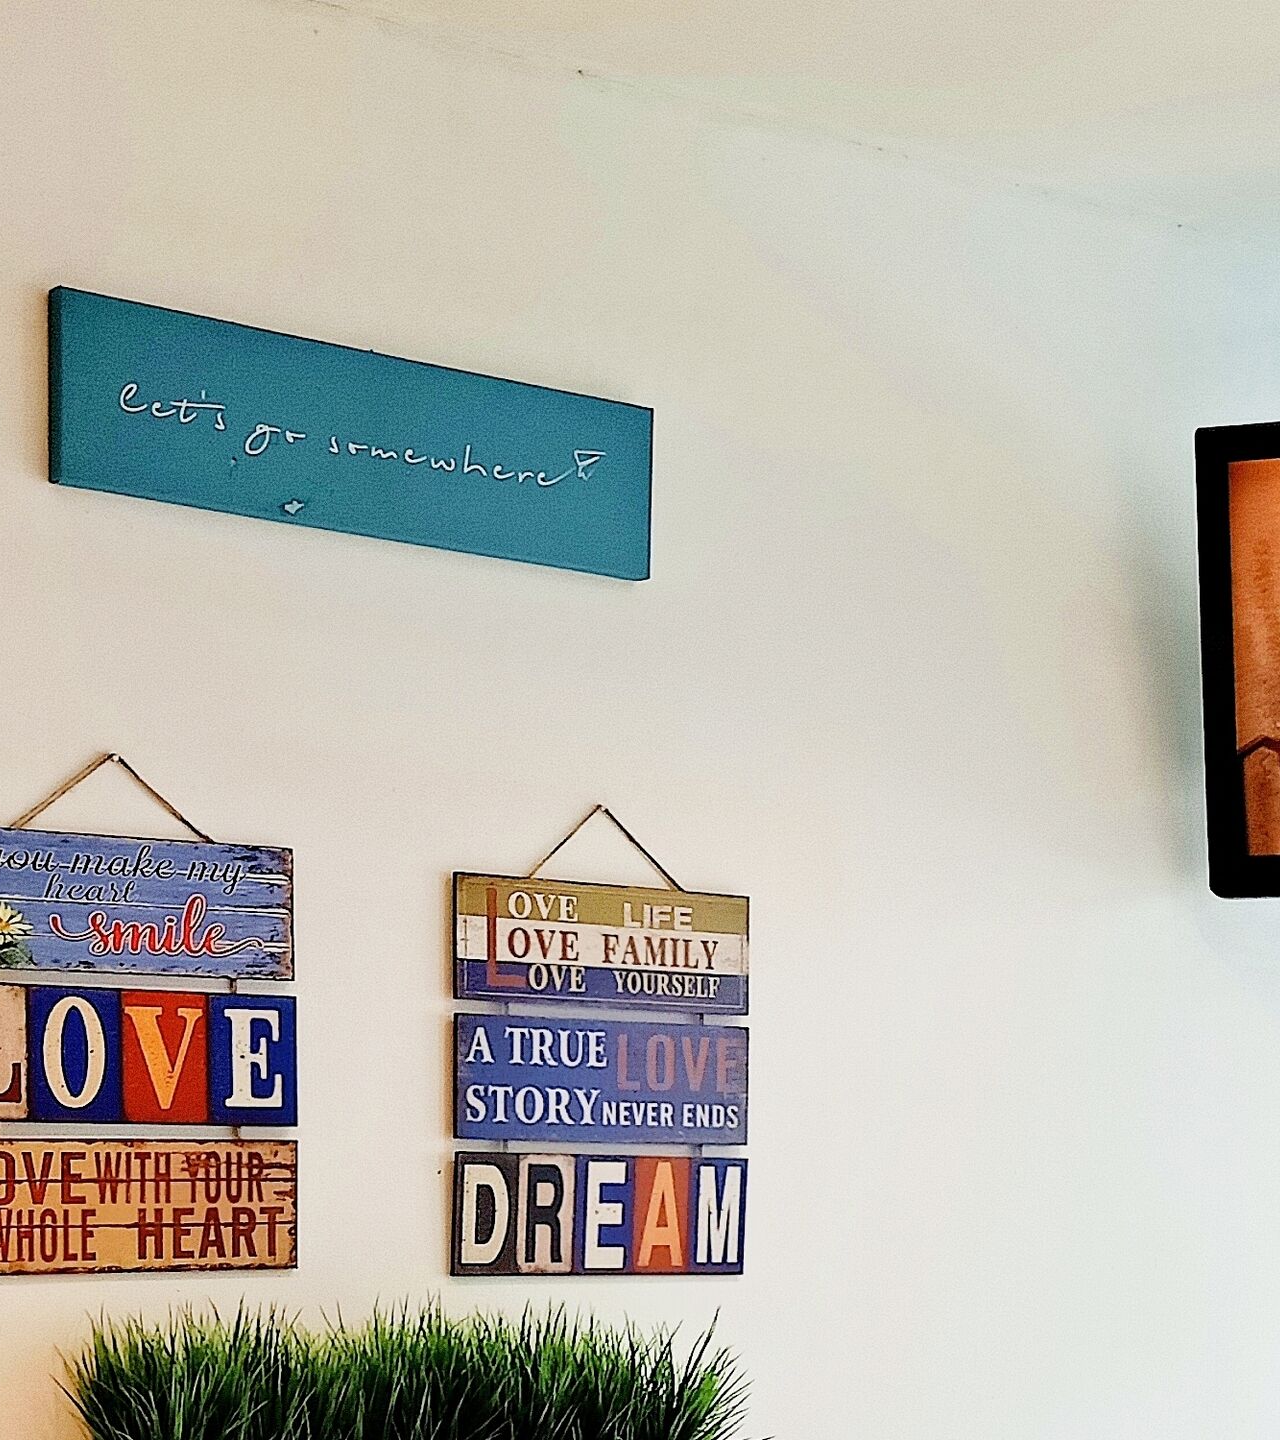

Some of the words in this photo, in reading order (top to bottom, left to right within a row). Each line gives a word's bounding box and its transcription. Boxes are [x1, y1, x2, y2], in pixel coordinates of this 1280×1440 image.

[244, 419, 306, 455] go
[328, 433, 577, 487] somewhere
[69, 845, 176, 880] make
[186, 858, 247, 896] my
[50, 894, 264, 958] smile
[622, 901, 694, 931] LIFE
[601, 933, 719, 971] FAMILY
[612, 969, 721, 999] YOURSELF
[465, 1026, 496, 1064] A
[504, 1026, 608, 1068] TRUE
[616, 1033, 744, 1095] LOVE
[465, 1084, 601, 1126] STORY
[602, 1101, 674, 1128] NEVER
[681, 1103, 740, 1129] ENDS
[94, 1151, 172, 1206] WITH
[182, 1150, 266, 1205] YOUR
[136, 1206, 285, 1262] HEART
[460, 1160, 743, 1270] DREAM
